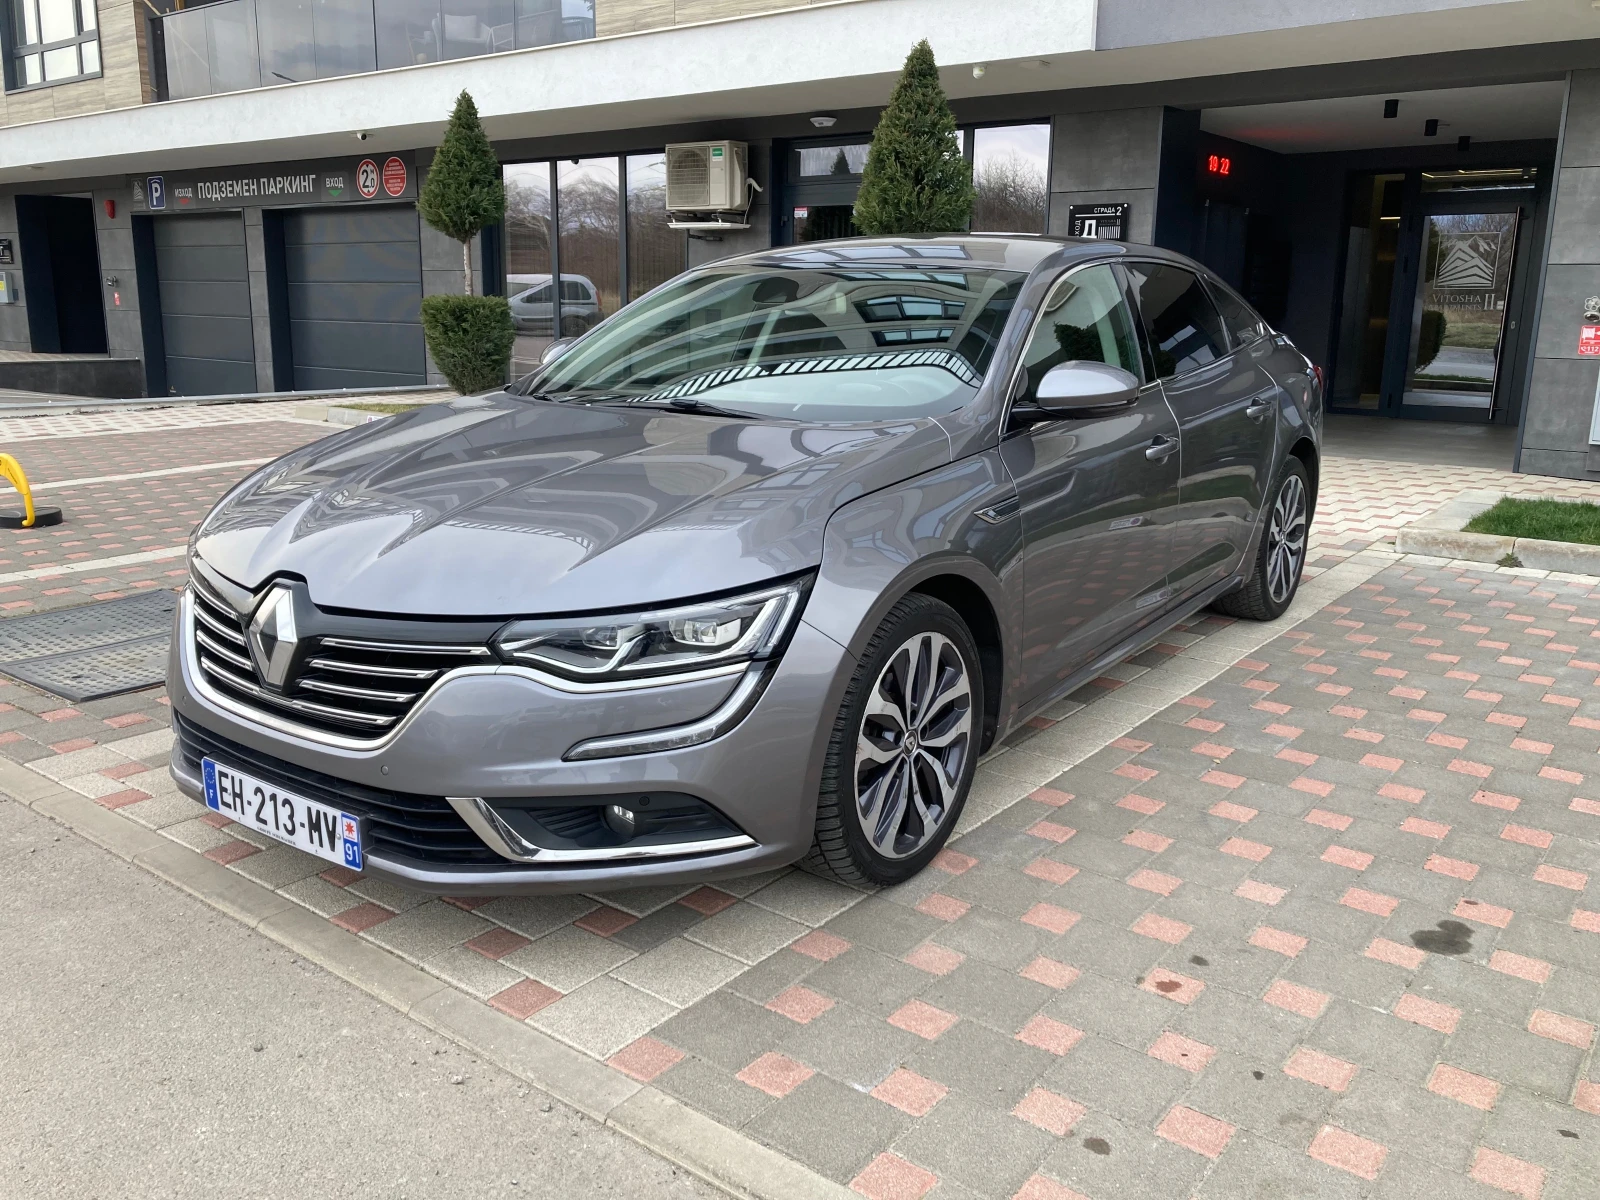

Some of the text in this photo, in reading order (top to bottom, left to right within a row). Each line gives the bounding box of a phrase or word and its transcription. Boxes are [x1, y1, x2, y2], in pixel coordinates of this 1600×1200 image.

[197, 174, 316, 202] ПОДЗЕМЕН ПАРКИНГ
[325, 177, 344, 188] ВХОД
[152, 182, 161, 205] P
[174, 187, 193, 198] ИЗХОД
[1116, 206, 1122, 216] 2
[1080, 219, 1097, 239] Д
[1432, 293, 1482, 303] VITOSHA
[209, 788, 214, 799] F
[217, 769, 337, 853] EH-213-MV
[345, 842, 360, 864] 91
